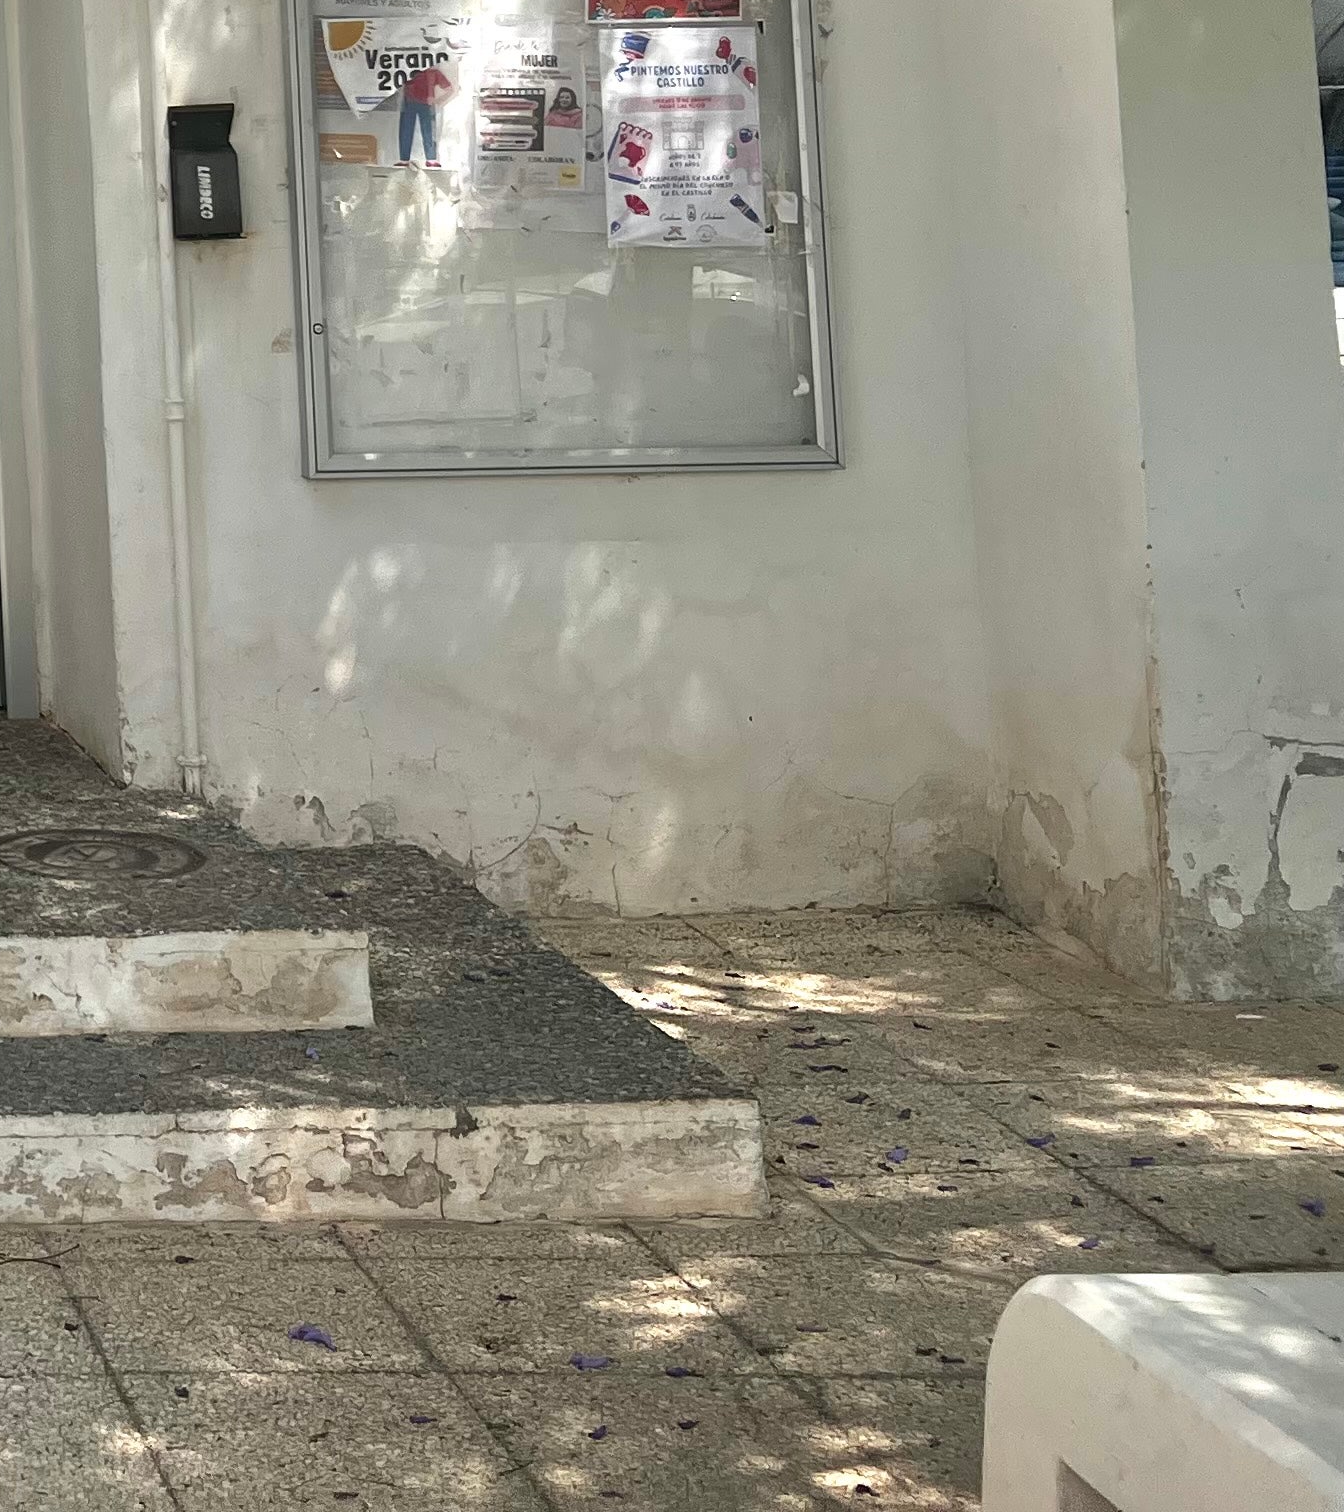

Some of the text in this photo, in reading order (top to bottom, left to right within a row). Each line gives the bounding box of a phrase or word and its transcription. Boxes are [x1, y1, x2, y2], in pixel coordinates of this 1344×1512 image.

[521, 54, 558, 68] MUJER
[631, 64, 729, 76] PINTEMOS NUESTRO
[656, 76, 705, 88] CASTILLO
